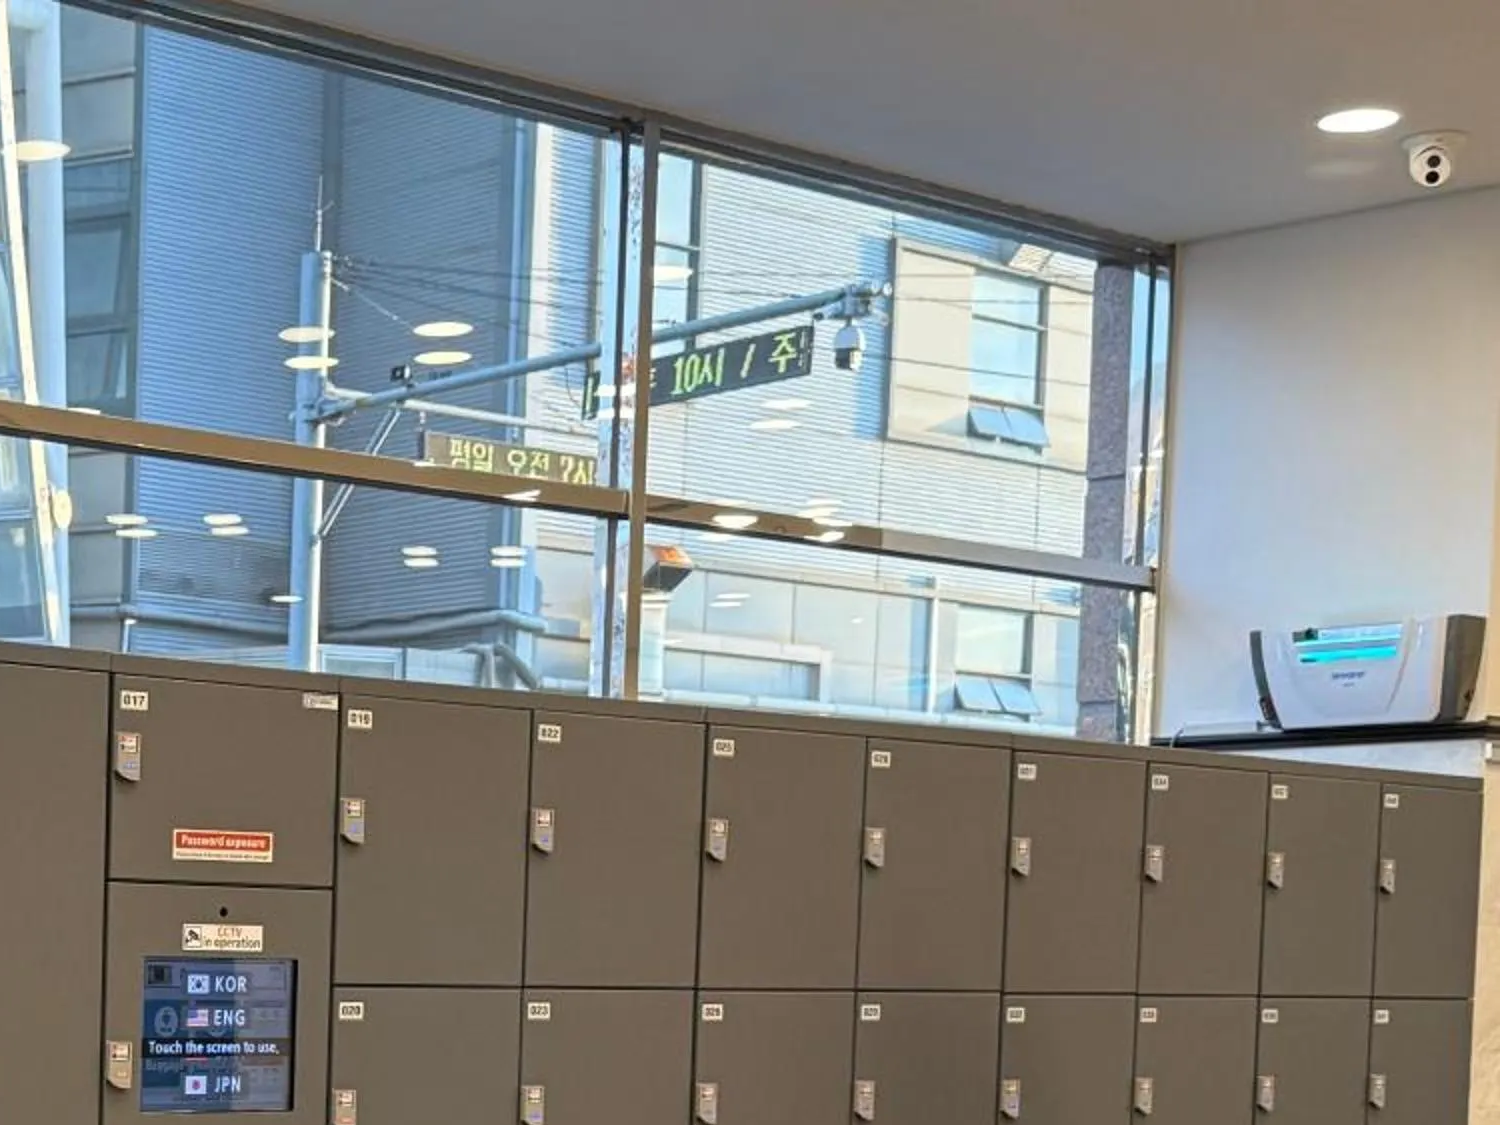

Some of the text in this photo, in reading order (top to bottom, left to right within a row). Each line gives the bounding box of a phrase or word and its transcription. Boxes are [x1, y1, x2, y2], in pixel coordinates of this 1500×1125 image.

[671, 347, 725, 395] 10시
[451, 438, 494, 473] 평일
[507, 449, 549, 480] 오전
[122, 693, 146, 707] 017
[181, 834, 225, 846] Password
[218, 927, 243, 937] CCTV
[214, 935, 261, 949] operation
[215, 975, 247, 993] KOR
[214, 1009, 246, 1025] ENG
[148, 1040, 182, 1054] Touch
[185, 1040, 205, 1054] the
[206, 1043, 241, 1054] screen
[243, 1042, 255, 1054] to
[214, 1075, 241, 1093] JPN
